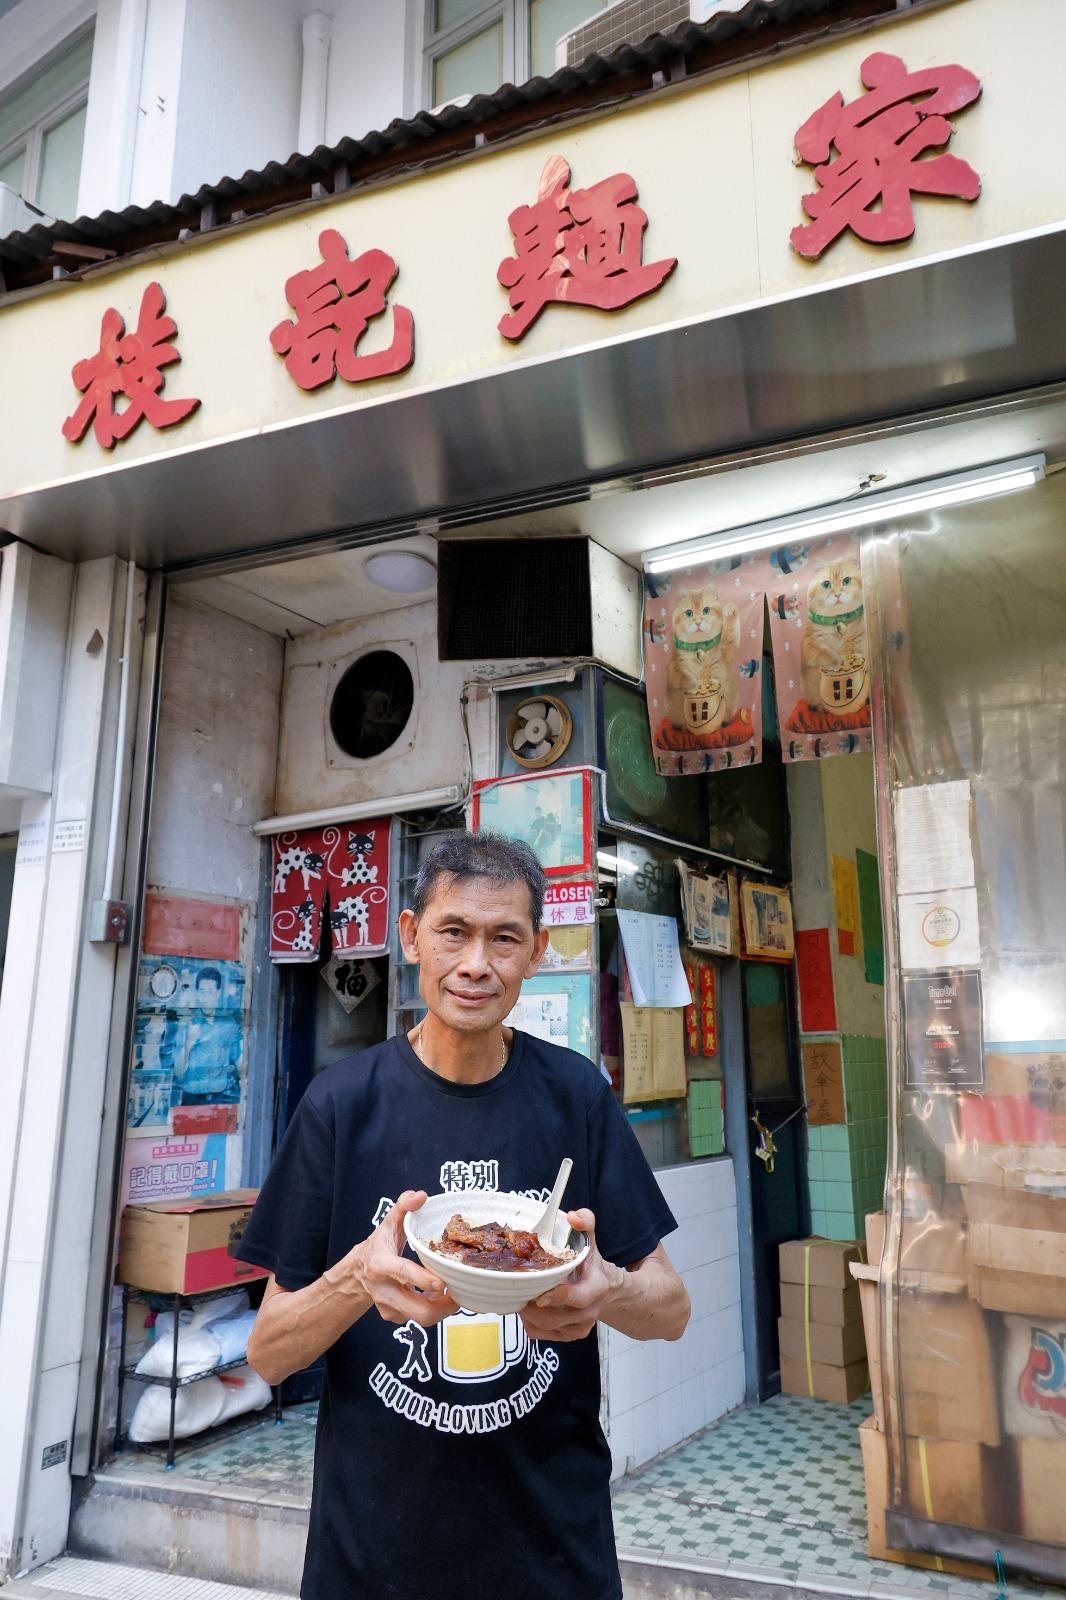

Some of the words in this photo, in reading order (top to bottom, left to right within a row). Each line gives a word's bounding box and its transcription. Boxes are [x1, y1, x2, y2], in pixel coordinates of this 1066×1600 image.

[544, 885, 593, 903] CLOSED
[550, 906, 588, 923] 休息
[440, 1159, 499, 1192] 特別
[510, 1347, 560, 1419] TROOPS
